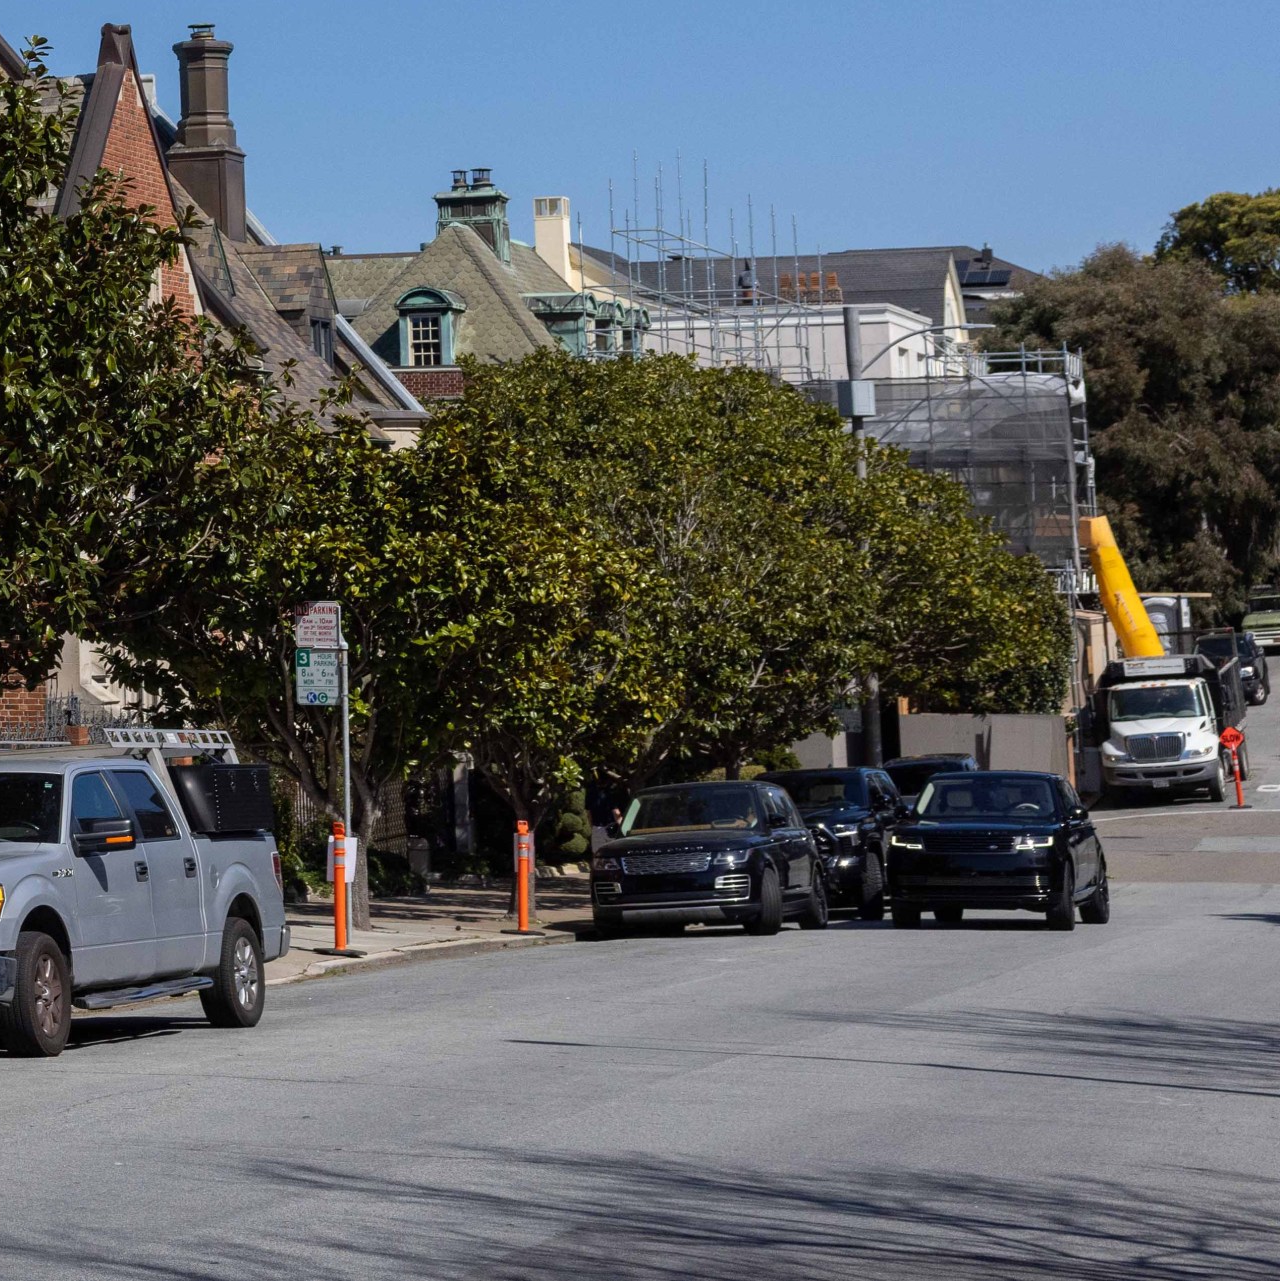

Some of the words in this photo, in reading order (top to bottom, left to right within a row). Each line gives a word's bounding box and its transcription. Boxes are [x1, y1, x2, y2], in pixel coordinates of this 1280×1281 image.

[297, 604, 309, 615] NO
[310, 606, 337, 615] PARKING
[299, 652, 308, 664] 3
[1221, 734, 1241, 743] SLOW
